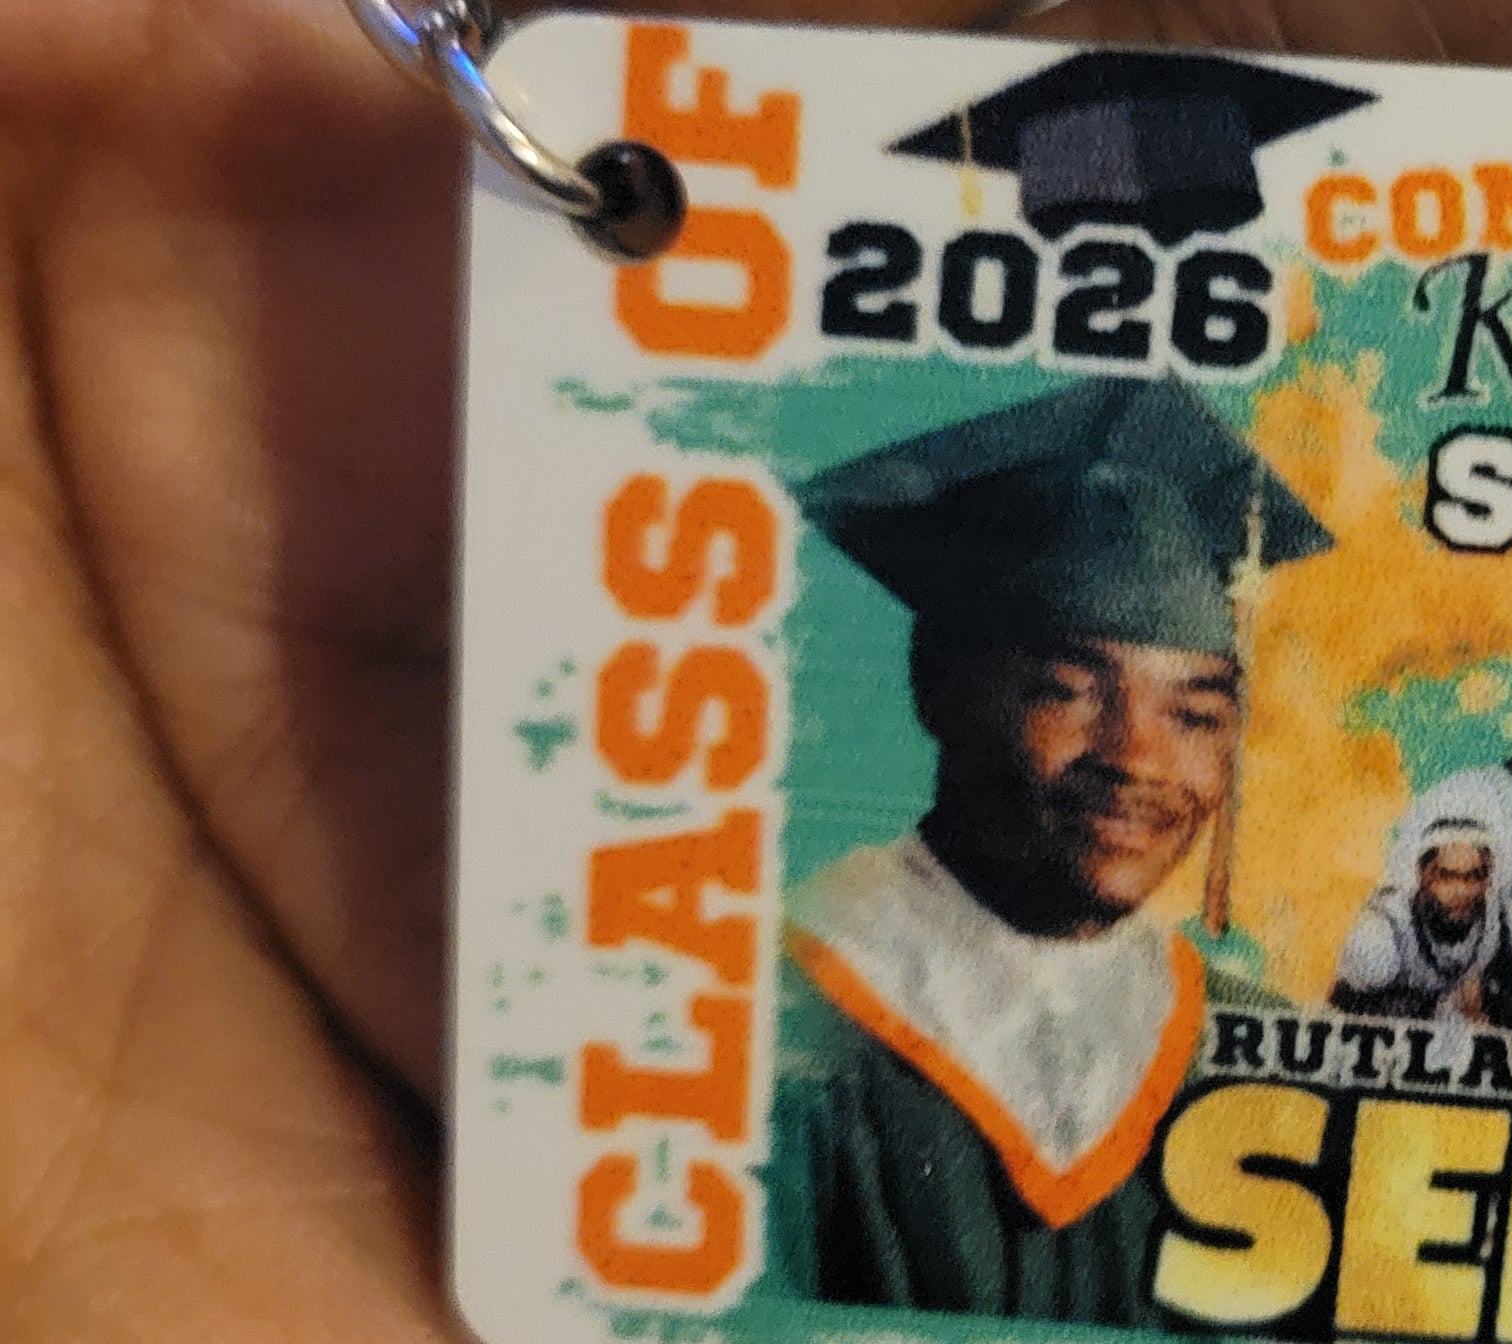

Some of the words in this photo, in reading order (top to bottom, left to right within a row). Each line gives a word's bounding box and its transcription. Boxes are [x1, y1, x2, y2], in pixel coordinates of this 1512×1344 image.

[613, 22, 803, 363] OF
[820, 221, 1274, 368] 2026
[574, 470, 780, 1298] CLASS
